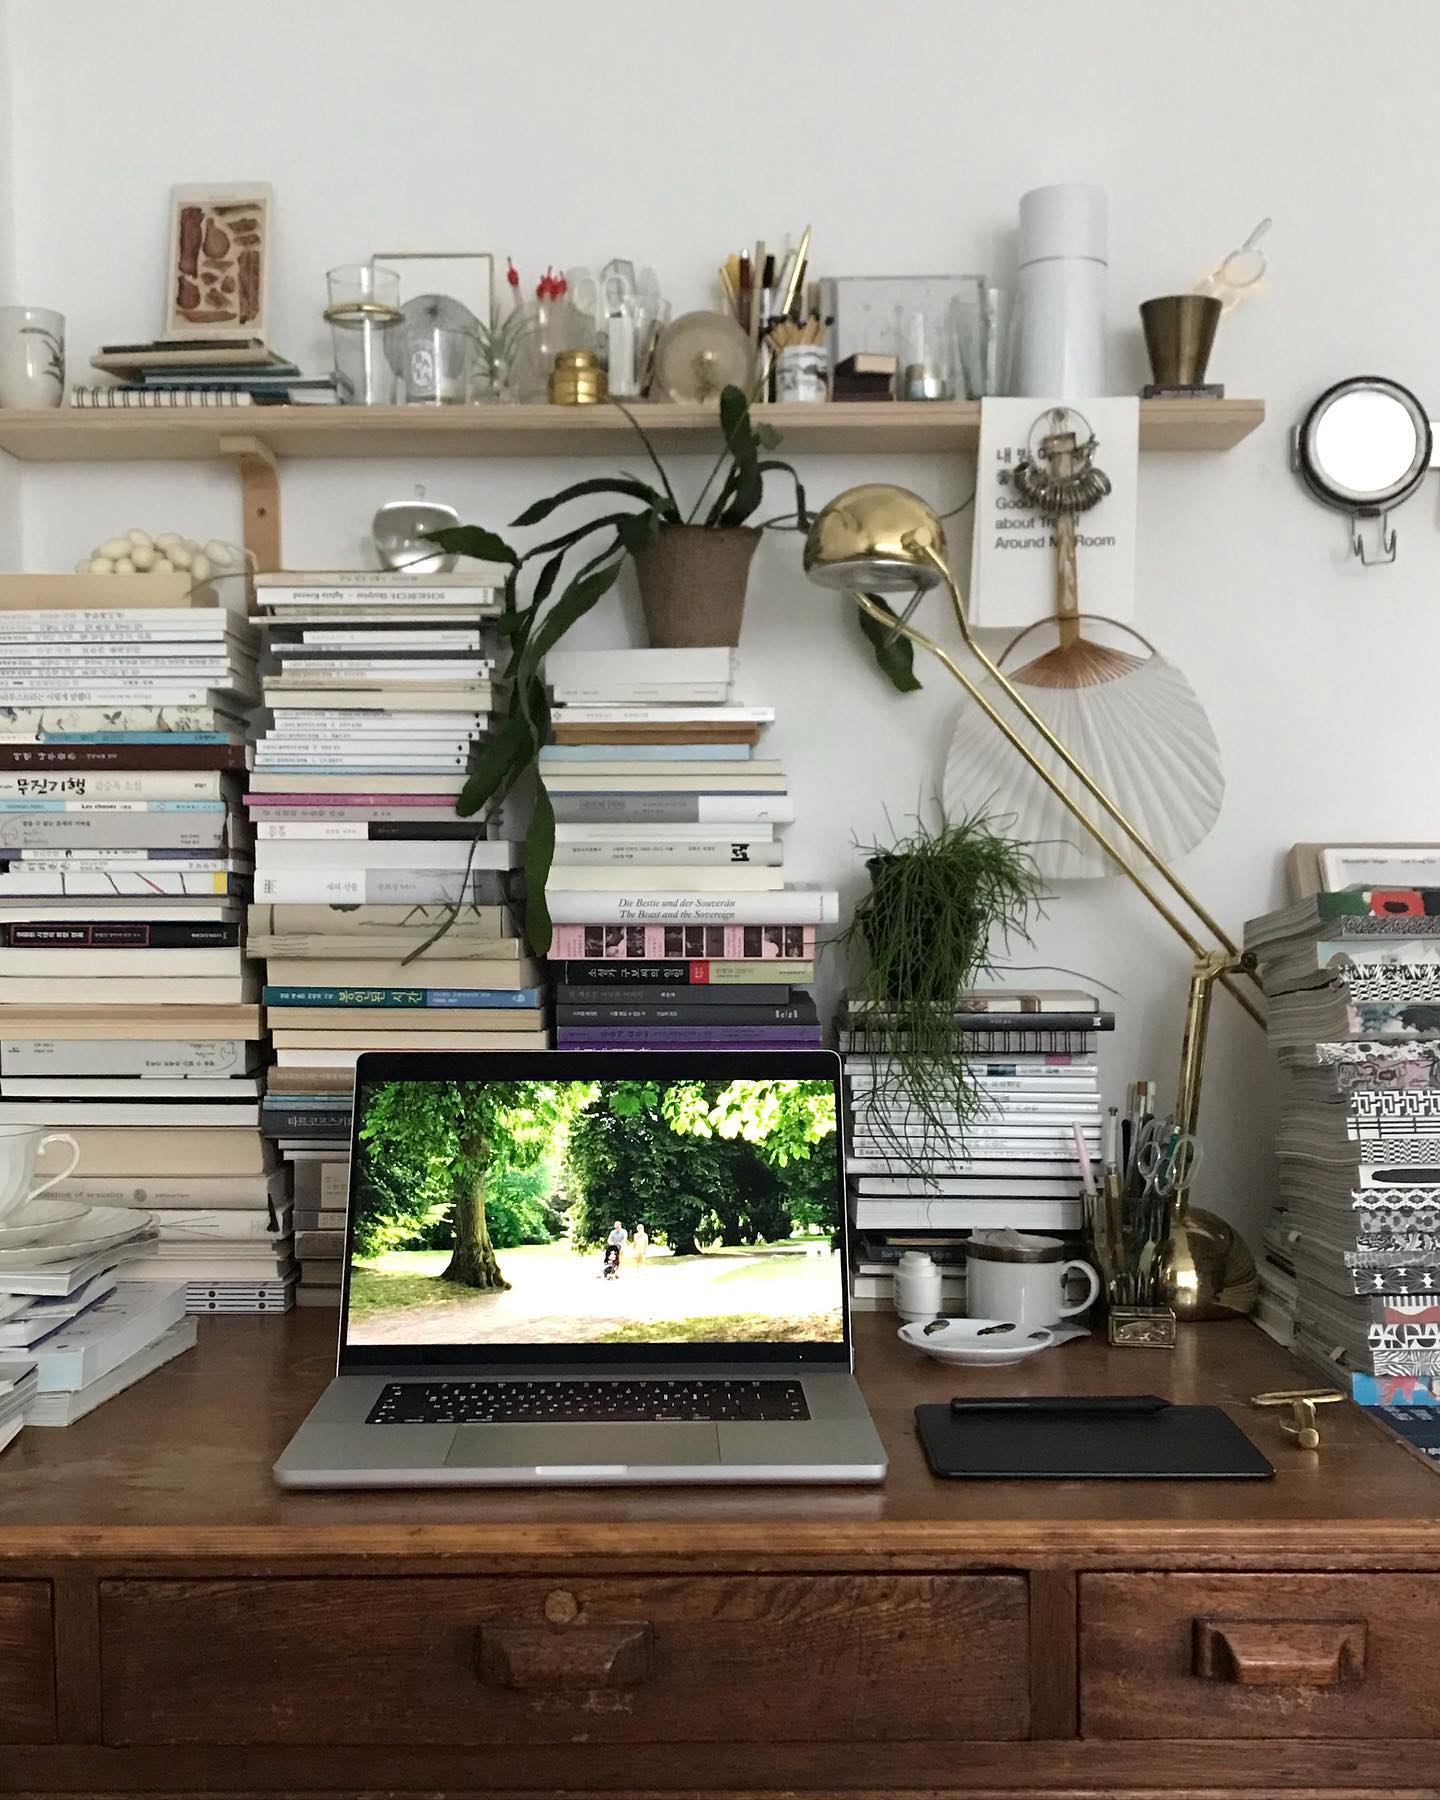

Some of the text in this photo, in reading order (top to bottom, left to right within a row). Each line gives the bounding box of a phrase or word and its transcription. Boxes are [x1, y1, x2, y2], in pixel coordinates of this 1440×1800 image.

[996, 447, 1012, 465] 내
[995, 516, 1035, 529] about
[995, 536, 1045, 549] Around
[1074, 534, 1116, 547] Room
[17, 777, 86, 797] 무진기행
[618, 899, 634, 908] Die
[635, 899, 660, 908] Bestie
[661, 899, 679, 908] und
[679, 899, 695, 908] der
[619, 910, 736, 920] The Beast and the Sovereign
[391, 989, 423, 1004] 시간
